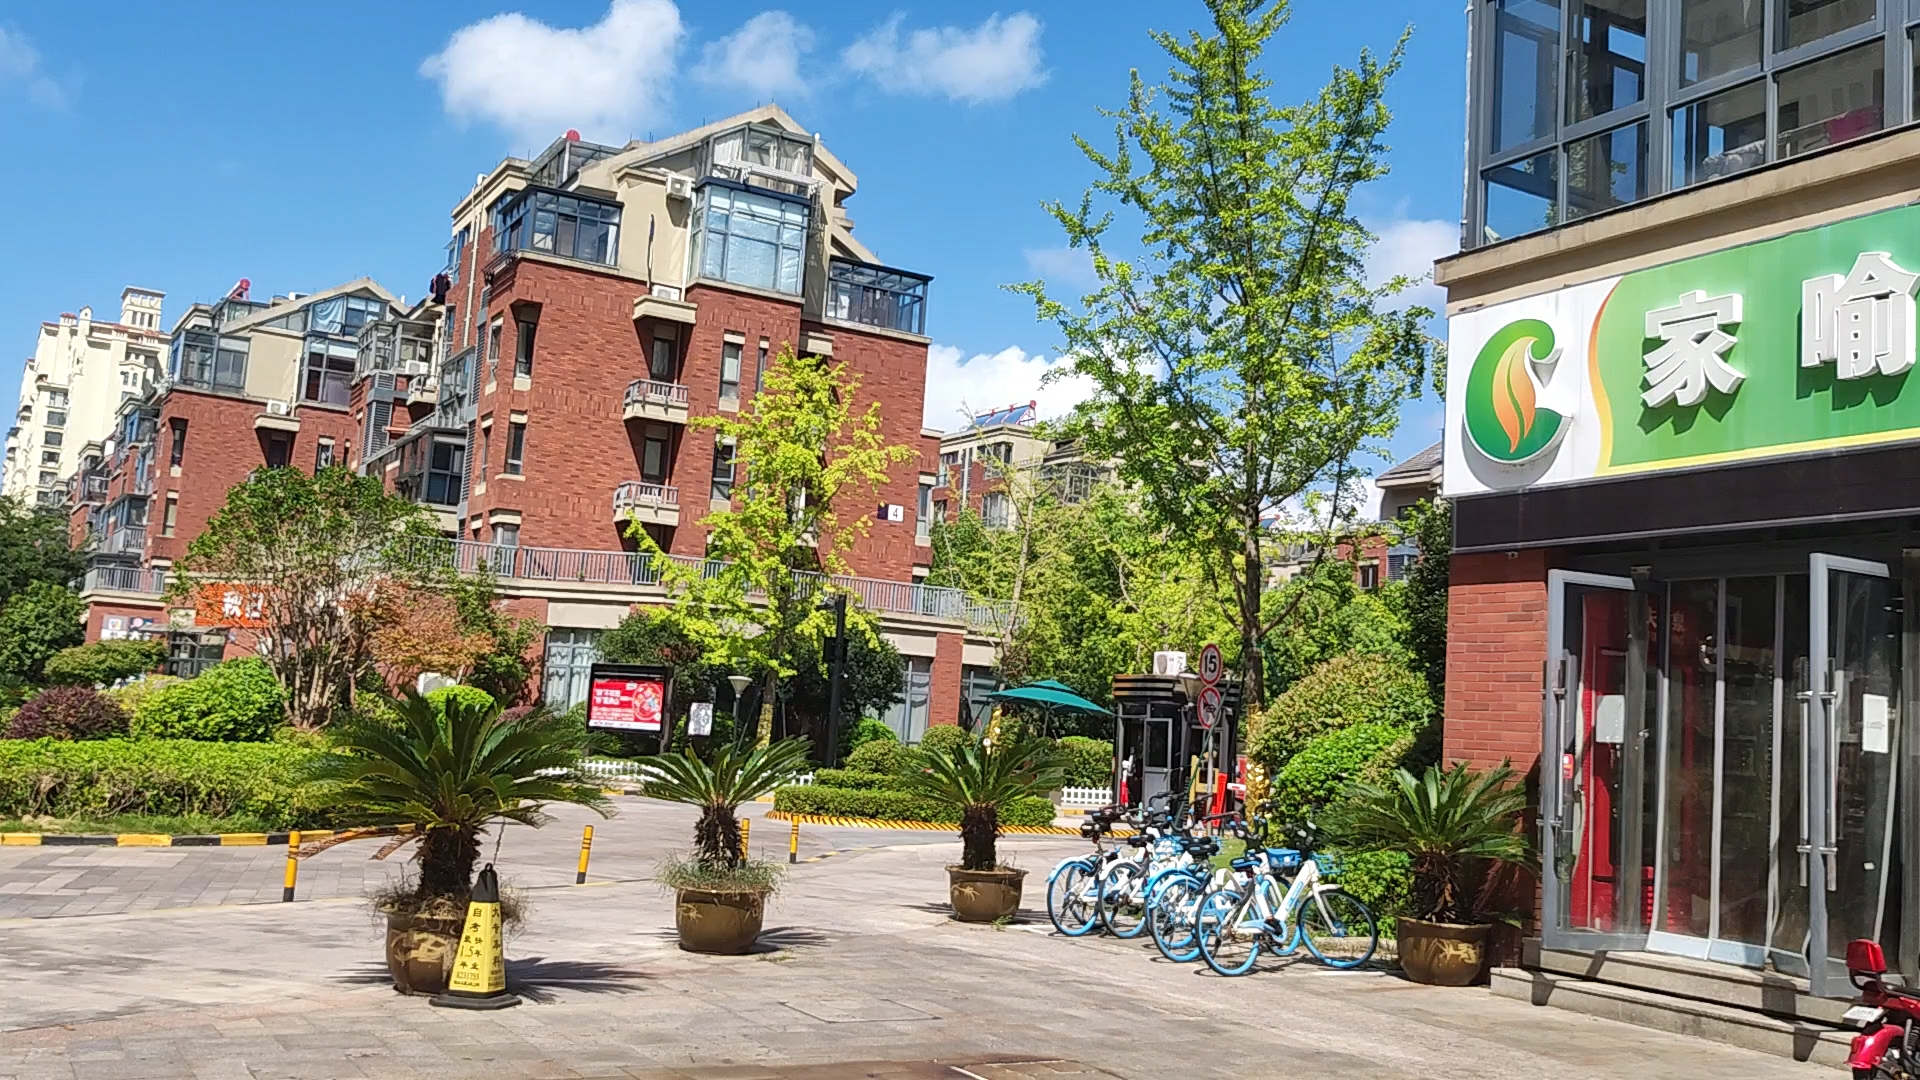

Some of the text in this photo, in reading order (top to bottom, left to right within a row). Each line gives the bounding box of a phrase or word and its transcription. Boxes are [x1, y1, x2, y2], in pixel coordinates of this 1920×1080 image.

[892, 507, 899, 519] 4
[1204, 654, 1217, 674] 15
[470, 907, 482, 933] 自考
